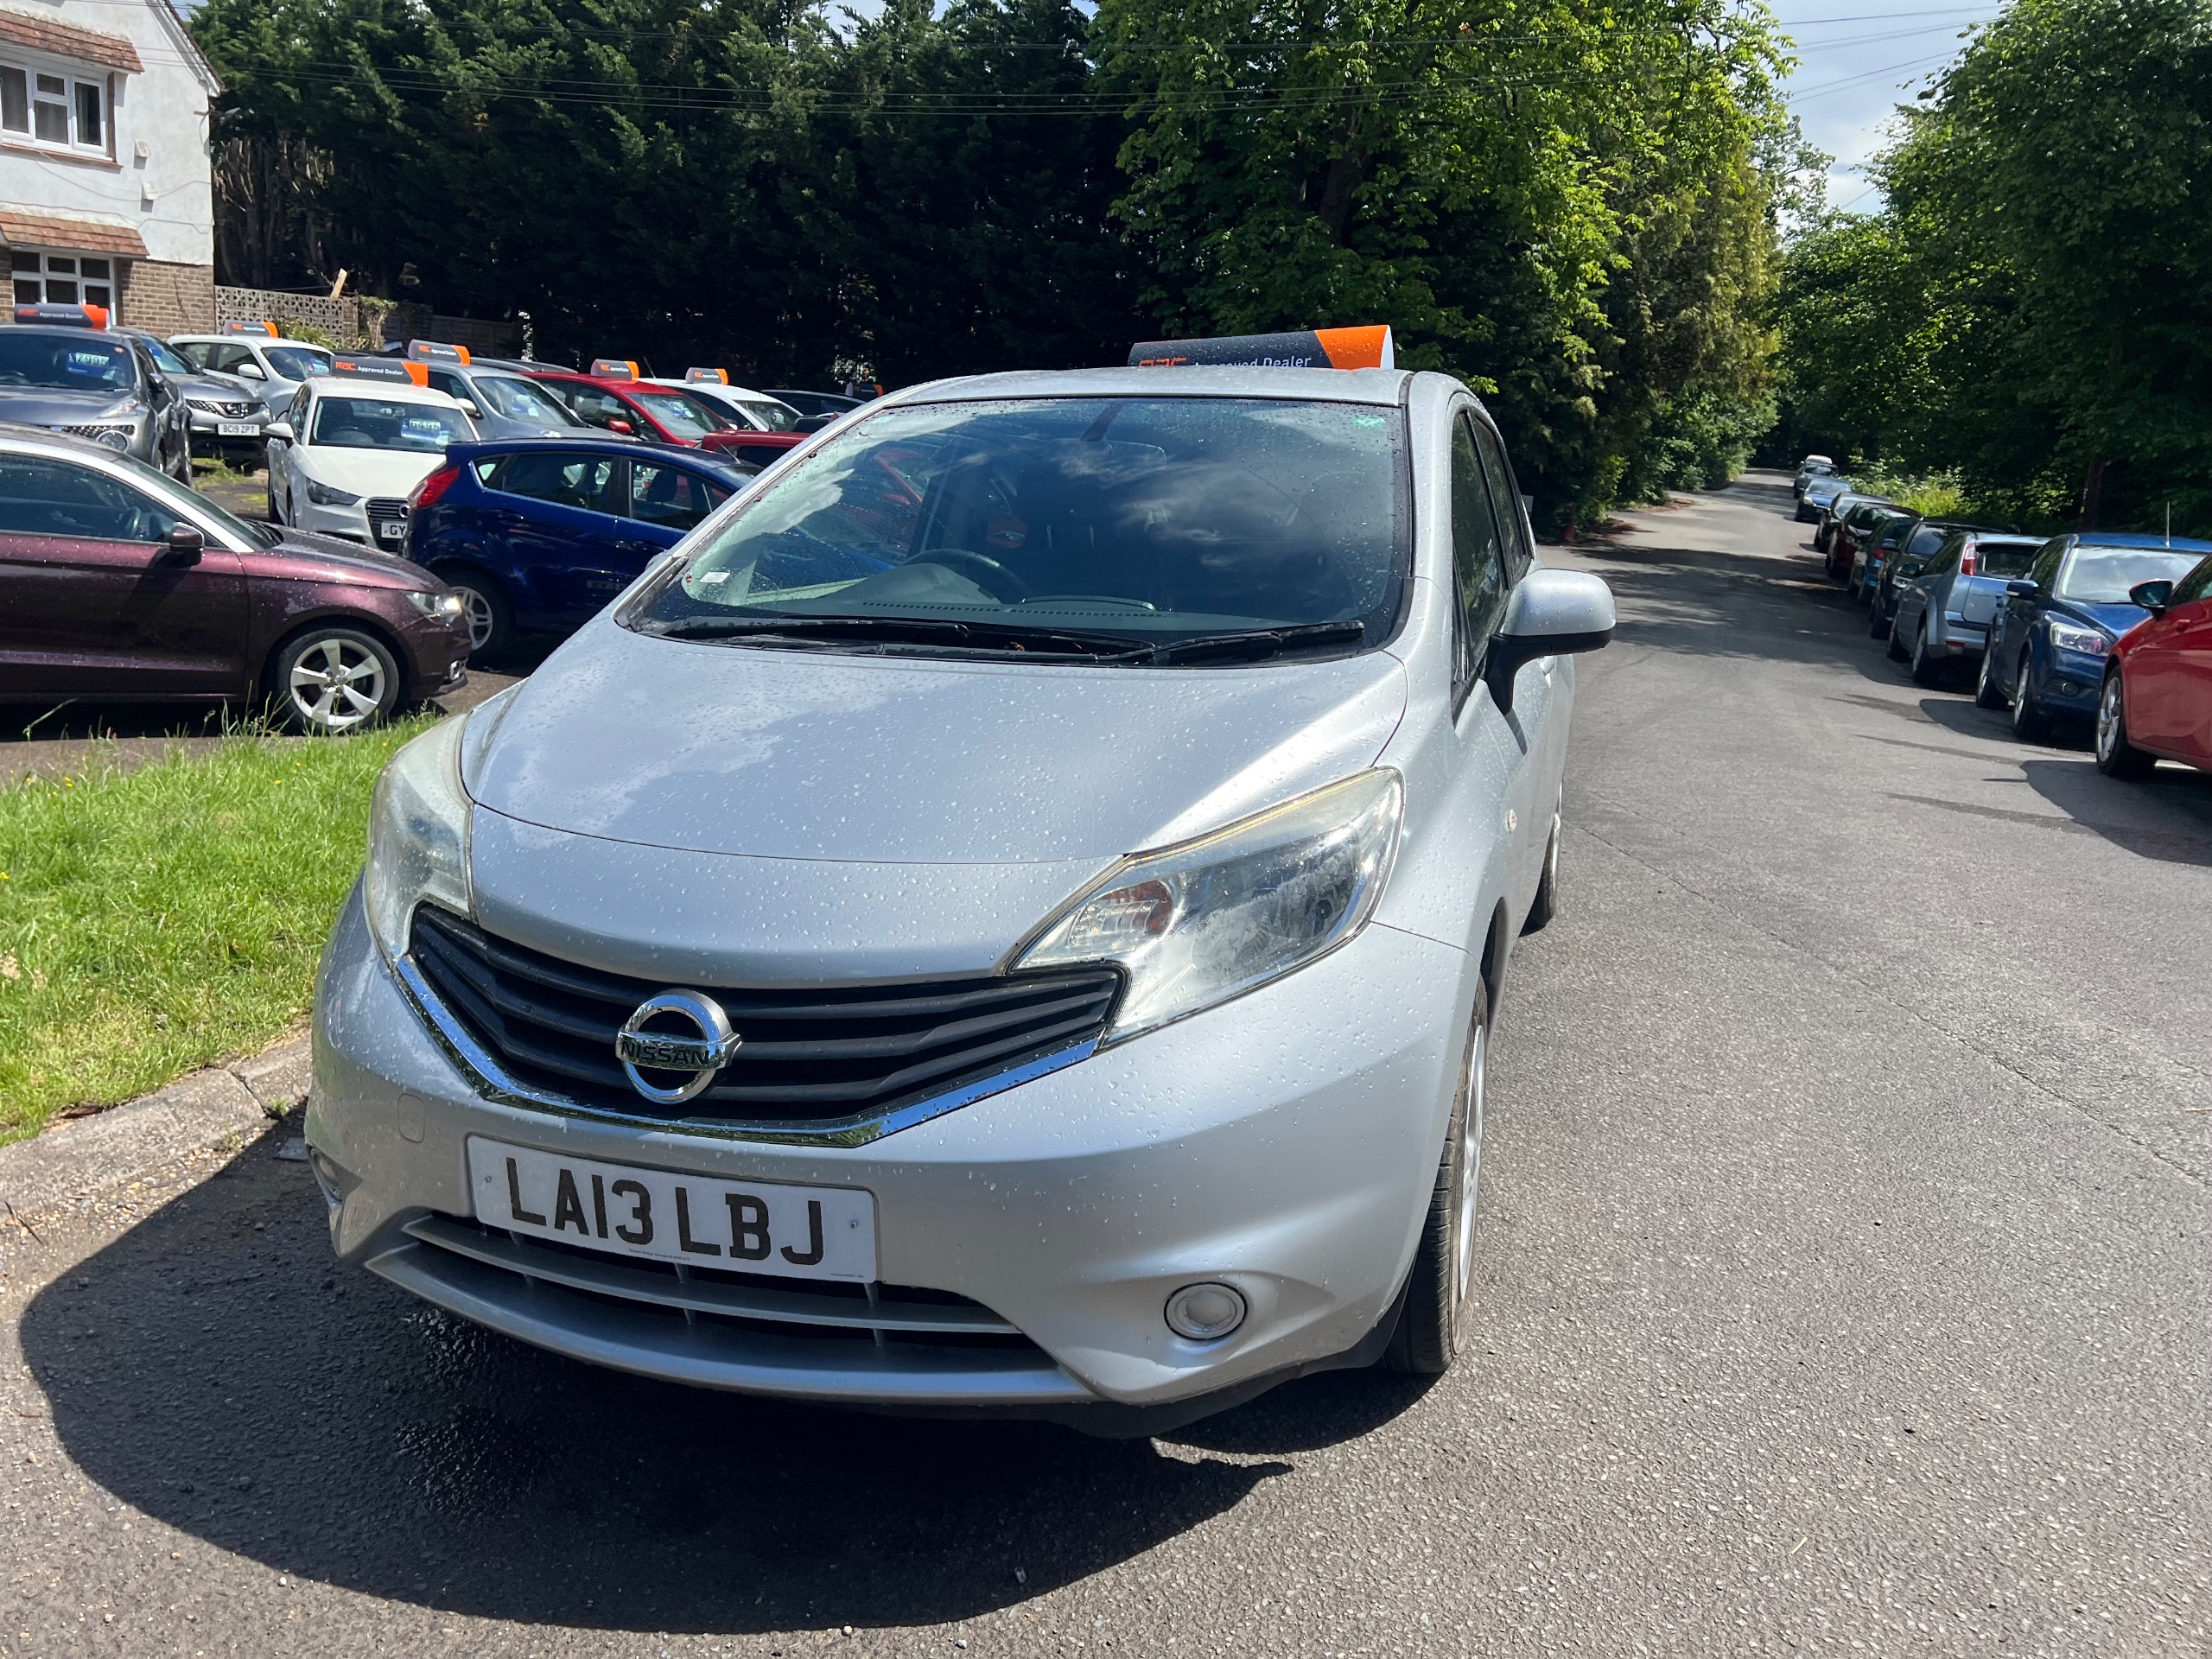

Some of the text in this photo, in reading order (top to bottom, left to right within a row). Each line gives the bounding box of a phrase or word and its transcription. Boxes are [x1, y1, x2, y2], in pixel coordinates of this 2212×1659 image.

[335, 361, 356, 371] RAC
[357, 365, 385, 374] Approved
[385, 367, 404, 376] Dealer
[223, 424, 255, 434] BC19 ZPT
[620, 1040, 710, 1065] NISSAN
[505, 1156, 824, 1266] LA13 LBJ
